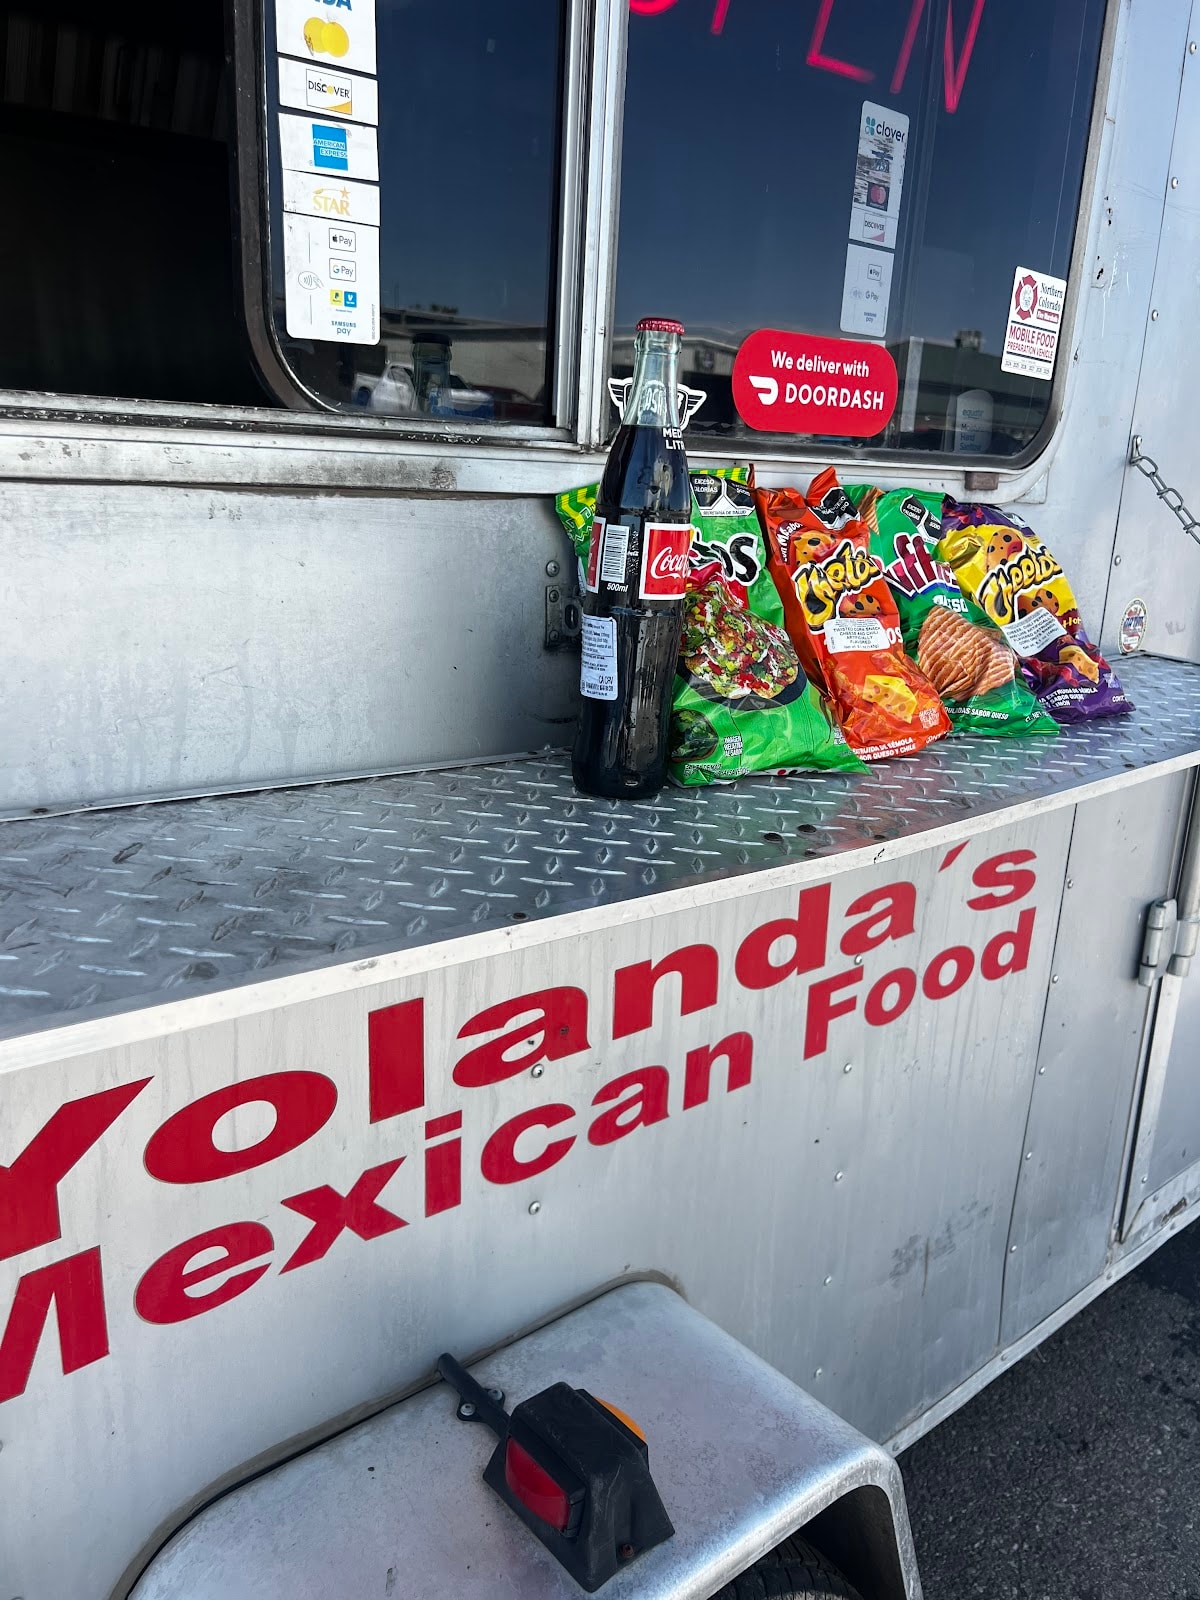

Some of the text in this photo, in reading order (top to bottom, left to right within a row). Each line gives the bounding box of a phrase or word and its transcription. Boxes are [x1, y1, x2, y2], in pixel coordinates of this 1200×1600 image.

[308, 80, 350, 98] DISCOVER
[876, 122, 905, 142] clover
[313, 138, 345, 149] AMERICAN
[320, 150, 348, 158] EXPRESS
[312, 196, 350, 216] STAR
[864, 220, 884, 230] DISCOVER
[338, 236, 352, 246] Pay
[341, 266, 354, 277] Pay
[1040, 282, 1063, 298] Northern
[1039, 296, 1061, 311] Colorado
[337, 328, 351, 336] pay
[1009, 325, 1054, 348] MOBILE FOOD
[1007, 341, 1053, 359] PREPARATION VEHICLE
[770, 350, 870, 377] We deliver with
[785, 383, 884, 410] DOORDASH
[662, 427, 683, 438] MED
[666, 440, 685, 450] LITR
[607, 583, 628, 592] 500ml
[971, 709, 990, 718] SABOR
[991, 712, 1009, 720] QUESO
[873, 750, 894, 759] QUESO
[900, 744, 916, 753] CHILE
[803, 907, 1036, 1061] Food
